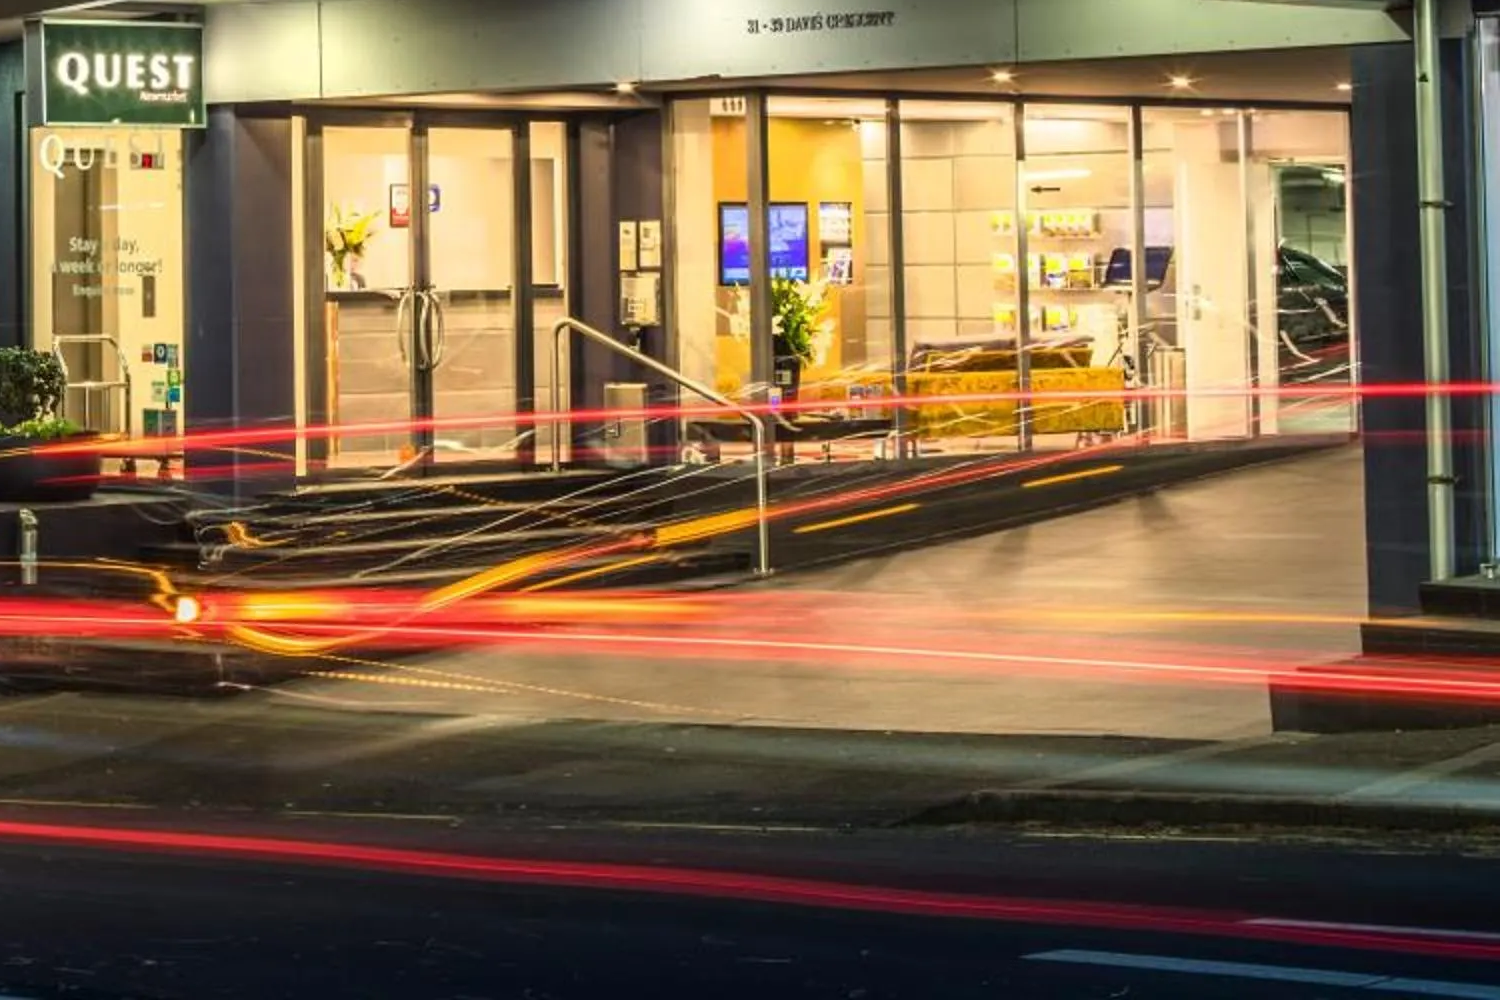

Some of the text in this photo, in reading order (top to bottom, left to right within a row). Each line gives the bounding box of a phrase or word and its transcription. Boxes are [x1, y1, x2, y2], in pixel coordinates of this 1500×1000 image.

[785, 14, 823, 32] DAVIS
[57, 51, 193, 95] QUEST
[69, 237, 97, 256] Stay
[60, 258, 94, 274] week
